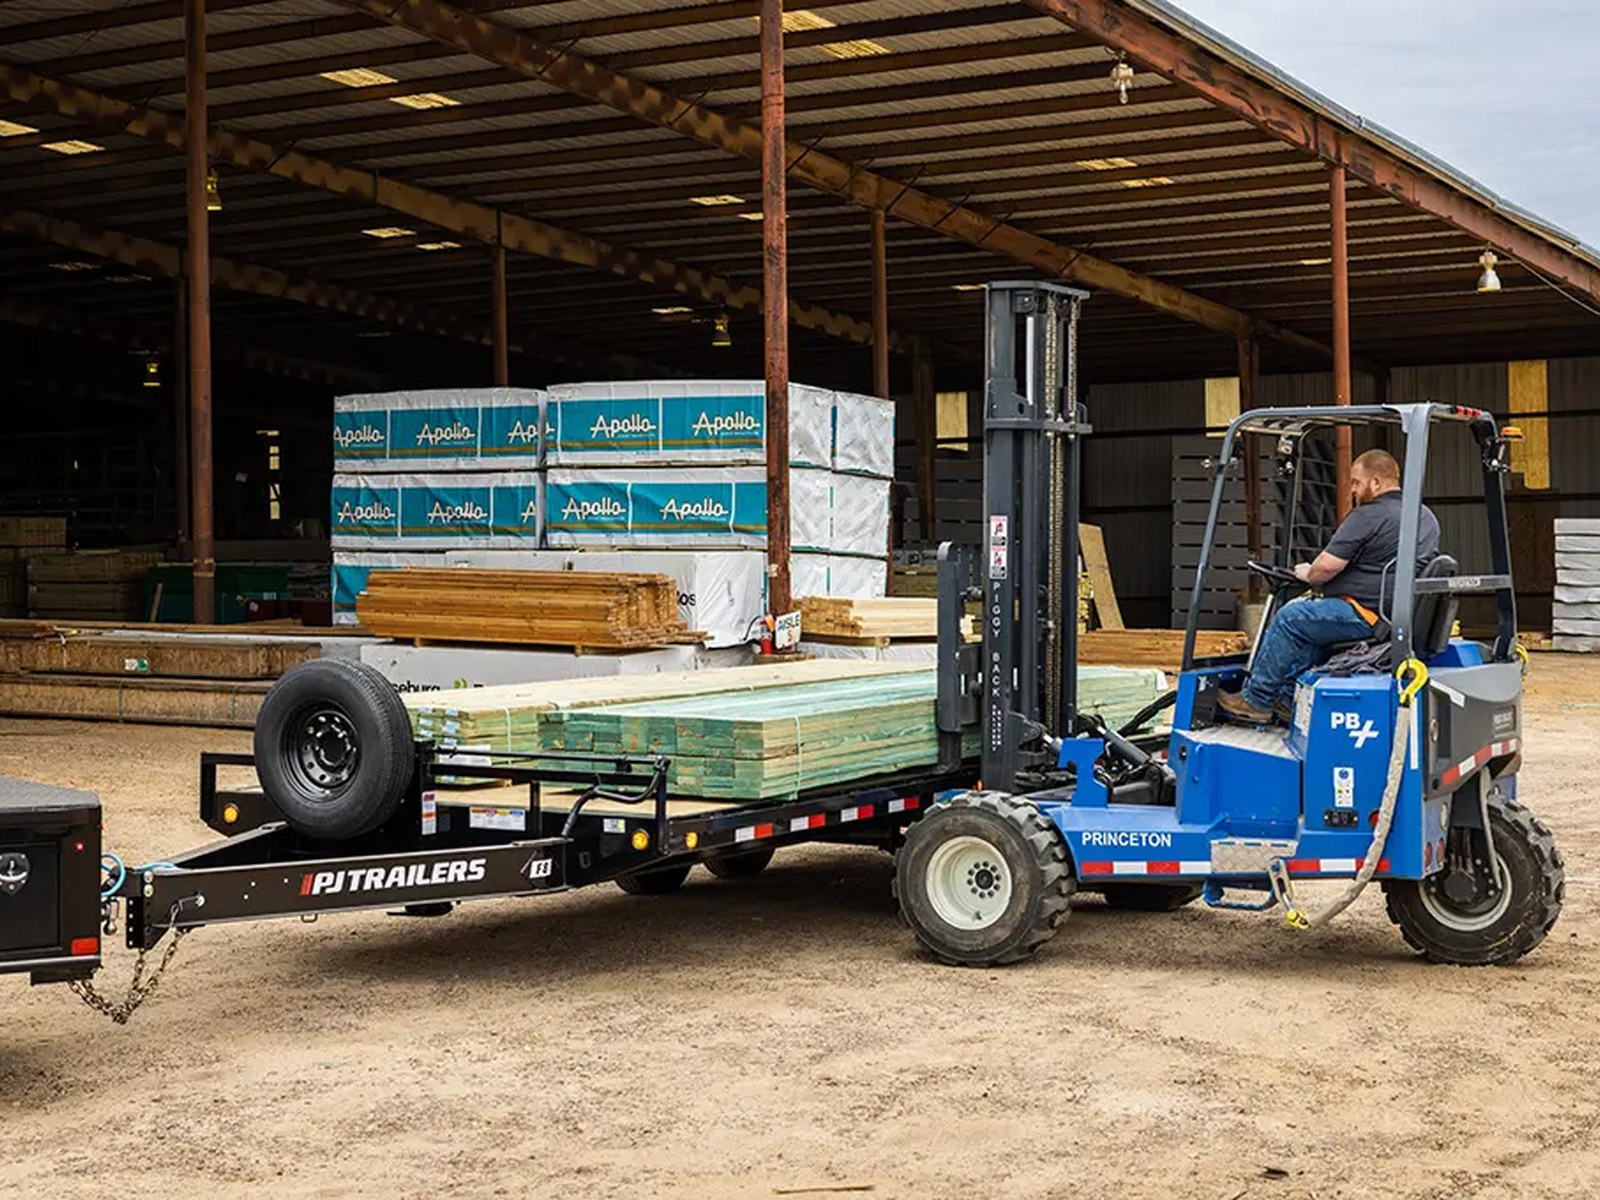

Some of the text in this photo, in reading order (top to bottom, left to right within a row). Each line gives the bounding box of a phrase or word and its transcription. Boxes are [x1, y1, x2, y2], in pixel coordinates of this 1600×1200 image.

[416, 422, 476, 445] Apollo
[590, 414, 656, 438] Apollo
[692, 411, 761, 436] Apollo
[333, 425, 384, 447] Apollo
[337, 501, 396, 523] Apollo
[427, 501, 488, 523] Apollo
[561, 497, 626, 520] Apollo
[660, 498, 728, 520] Apollo
[778, 614, 799, 629] AISLE
[992, 652, 1001, 697] BACK
[1082, 831, 1172, 848] PRINCETON
